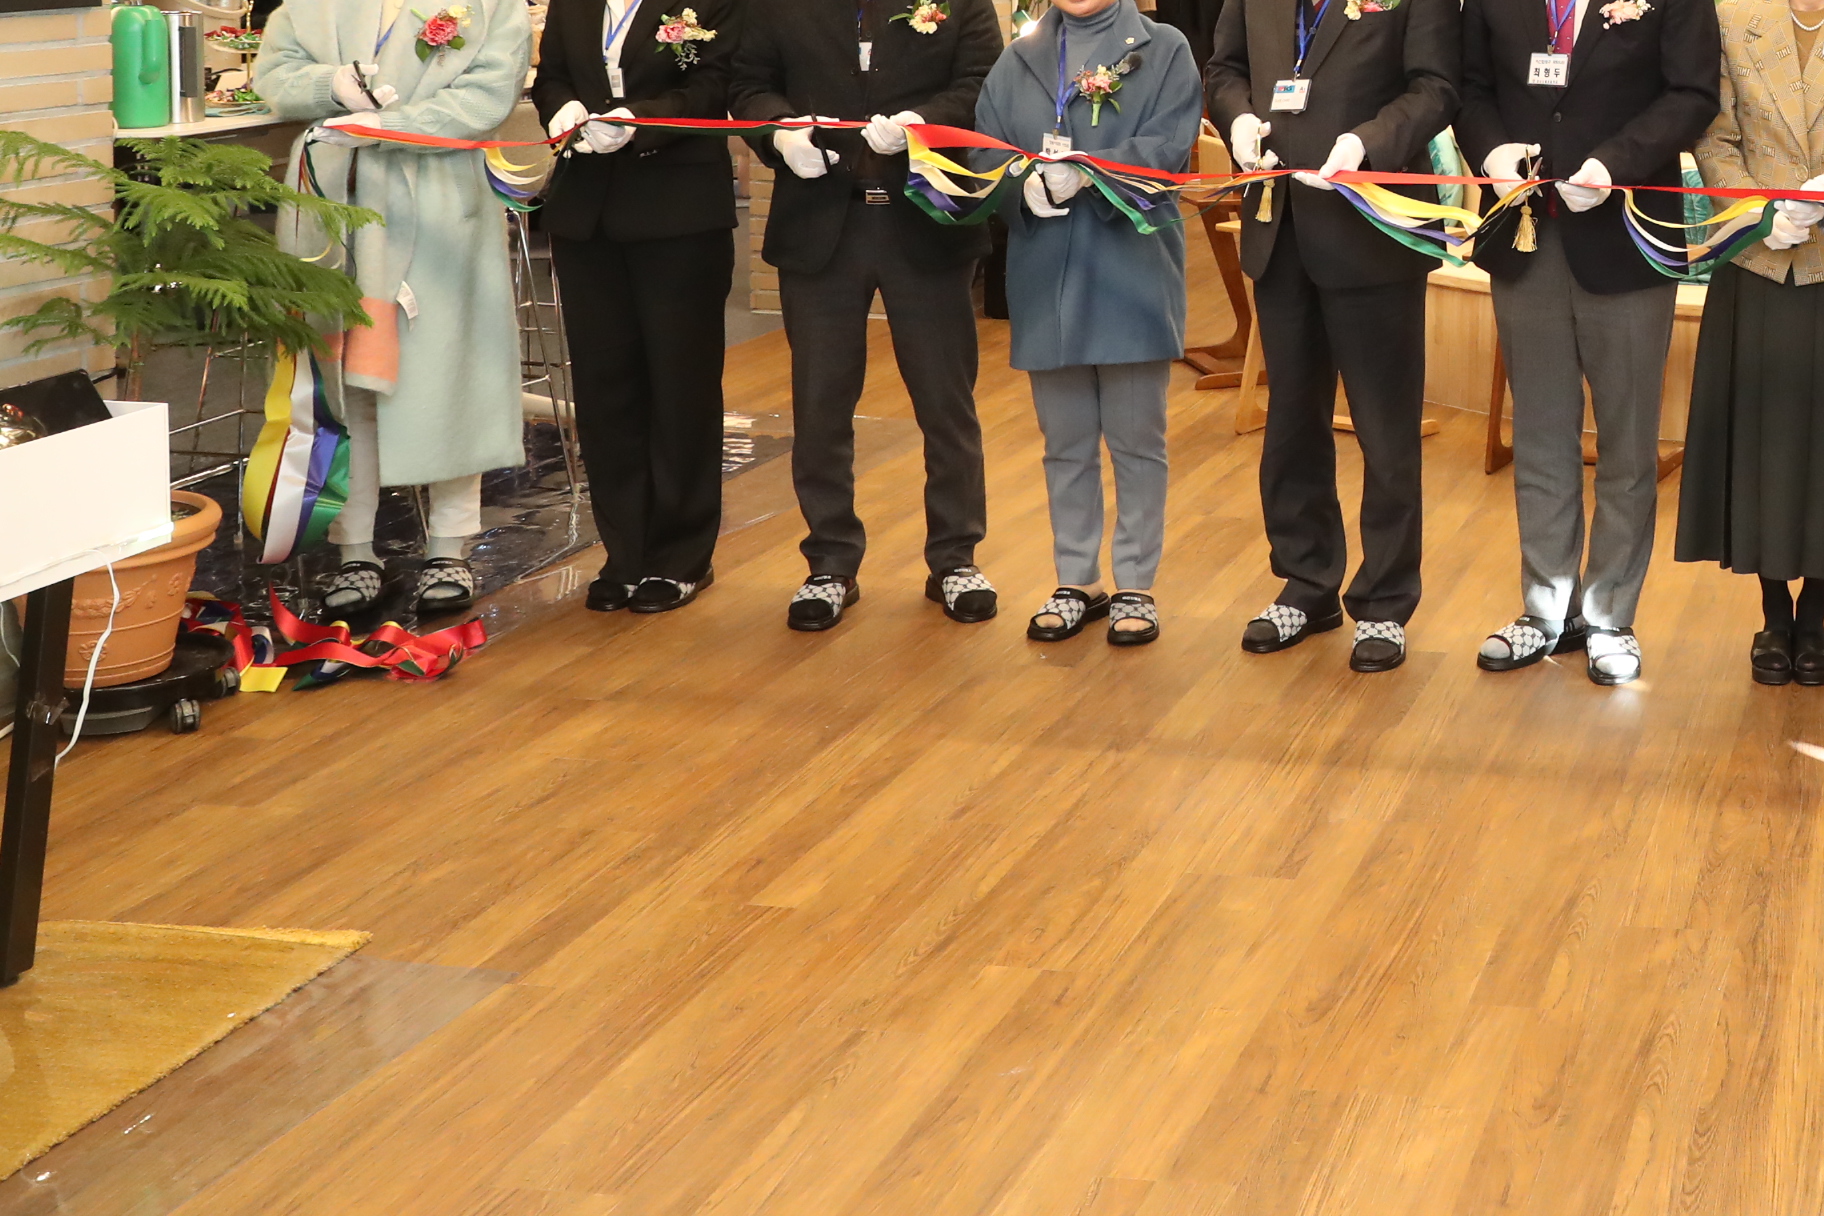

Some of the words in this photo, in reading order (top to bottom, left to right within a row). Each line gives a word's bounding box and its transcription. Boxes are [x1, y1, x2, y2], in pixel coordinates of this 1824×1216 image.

[1776, 46, 1791, 59] TIME
[1738, 66, 1750, 76] TIME
[1761, 110, 1772, 120] TIME
[1698, 151, 1712, 160] TIME
[1763, 146, 1775, 157] TIME
[1808, 272, 1824, 283] TIME
